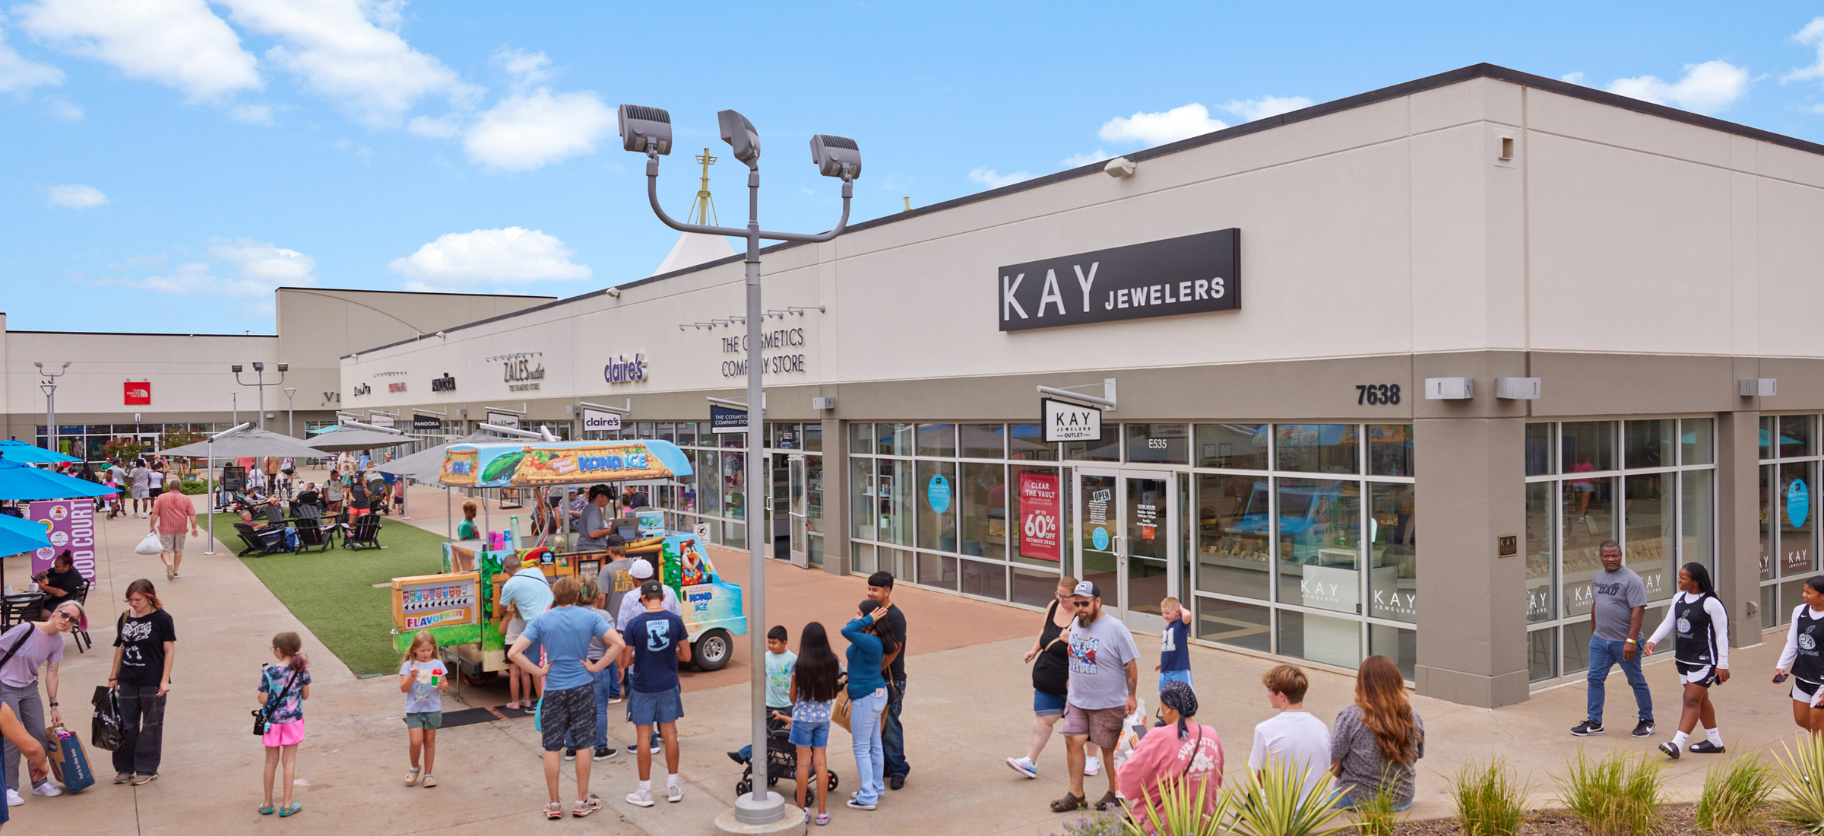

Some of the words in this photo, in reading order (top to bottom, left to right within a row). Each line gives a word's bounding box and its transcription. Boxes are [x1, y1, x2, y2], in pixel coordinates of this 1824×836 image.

[1003, 261, 1100, 321] KAY
[1104, 276, 1225, 311] JEWELERS
[721, 336, 738, 353] THE
[742, 327, 804, 351] CSMETICS
[504, 359, 529, 382] ZALES
[604, 353, 643, 383] claire's
[772, 354, 804, 374] STORE
[1355, 384, 1401, 406] 7638
[586, 417, 619, 427] claire's
[1056, 412, 1090, 426] KAY
[1148, 438, 1167, 449] E535
[577, 455, 623, 472] KONA
[622, 453, 648, 469] ICE
[1031, 481, 1050, 490] CLEAR
[1025, 489, 1037, 497] THE
[1037, 490, 1055, 499] VAULT
[1094, 490, 1110, 502] OPEN
[70, 501, 94, 547] COURT
[1024, 514, 1056, 538] 60%
[1045, 532, 1056, 540] OFF
[1500, 537, 1516, 547] KAY
[1788, 549, 1807, 563] KAY
[72, 550, 95, 585] OOD
[614, 569, 633, 581] FO
[1641, 574, 1661, 588] AY
[1301, 579, 1338, 597] KAY
[1575, 586, 1593, 602] KA
[1597, 587, 1620, 597] DAD
[1646, 587, 1661, 595] ELERS
[689, 591, 713, 603] KONA
[1301, 594, 1339, 603] JEWELERS
[1374, 590, 1416, 608] KAY
[1527, 590, 1547, 609] AY
[1576, 599, 1594, 607] JEWEL
[694, 602, 708, 612] ICE
[1374, 604, 1416, 615] JEWELERS
[406, 609, 464, 629] FLAVORWAVE
[1679, 620, 1688, 631] 12
[1800, 635, 1813, 648] 24
[1177, 738, 1196, 761] SURF
